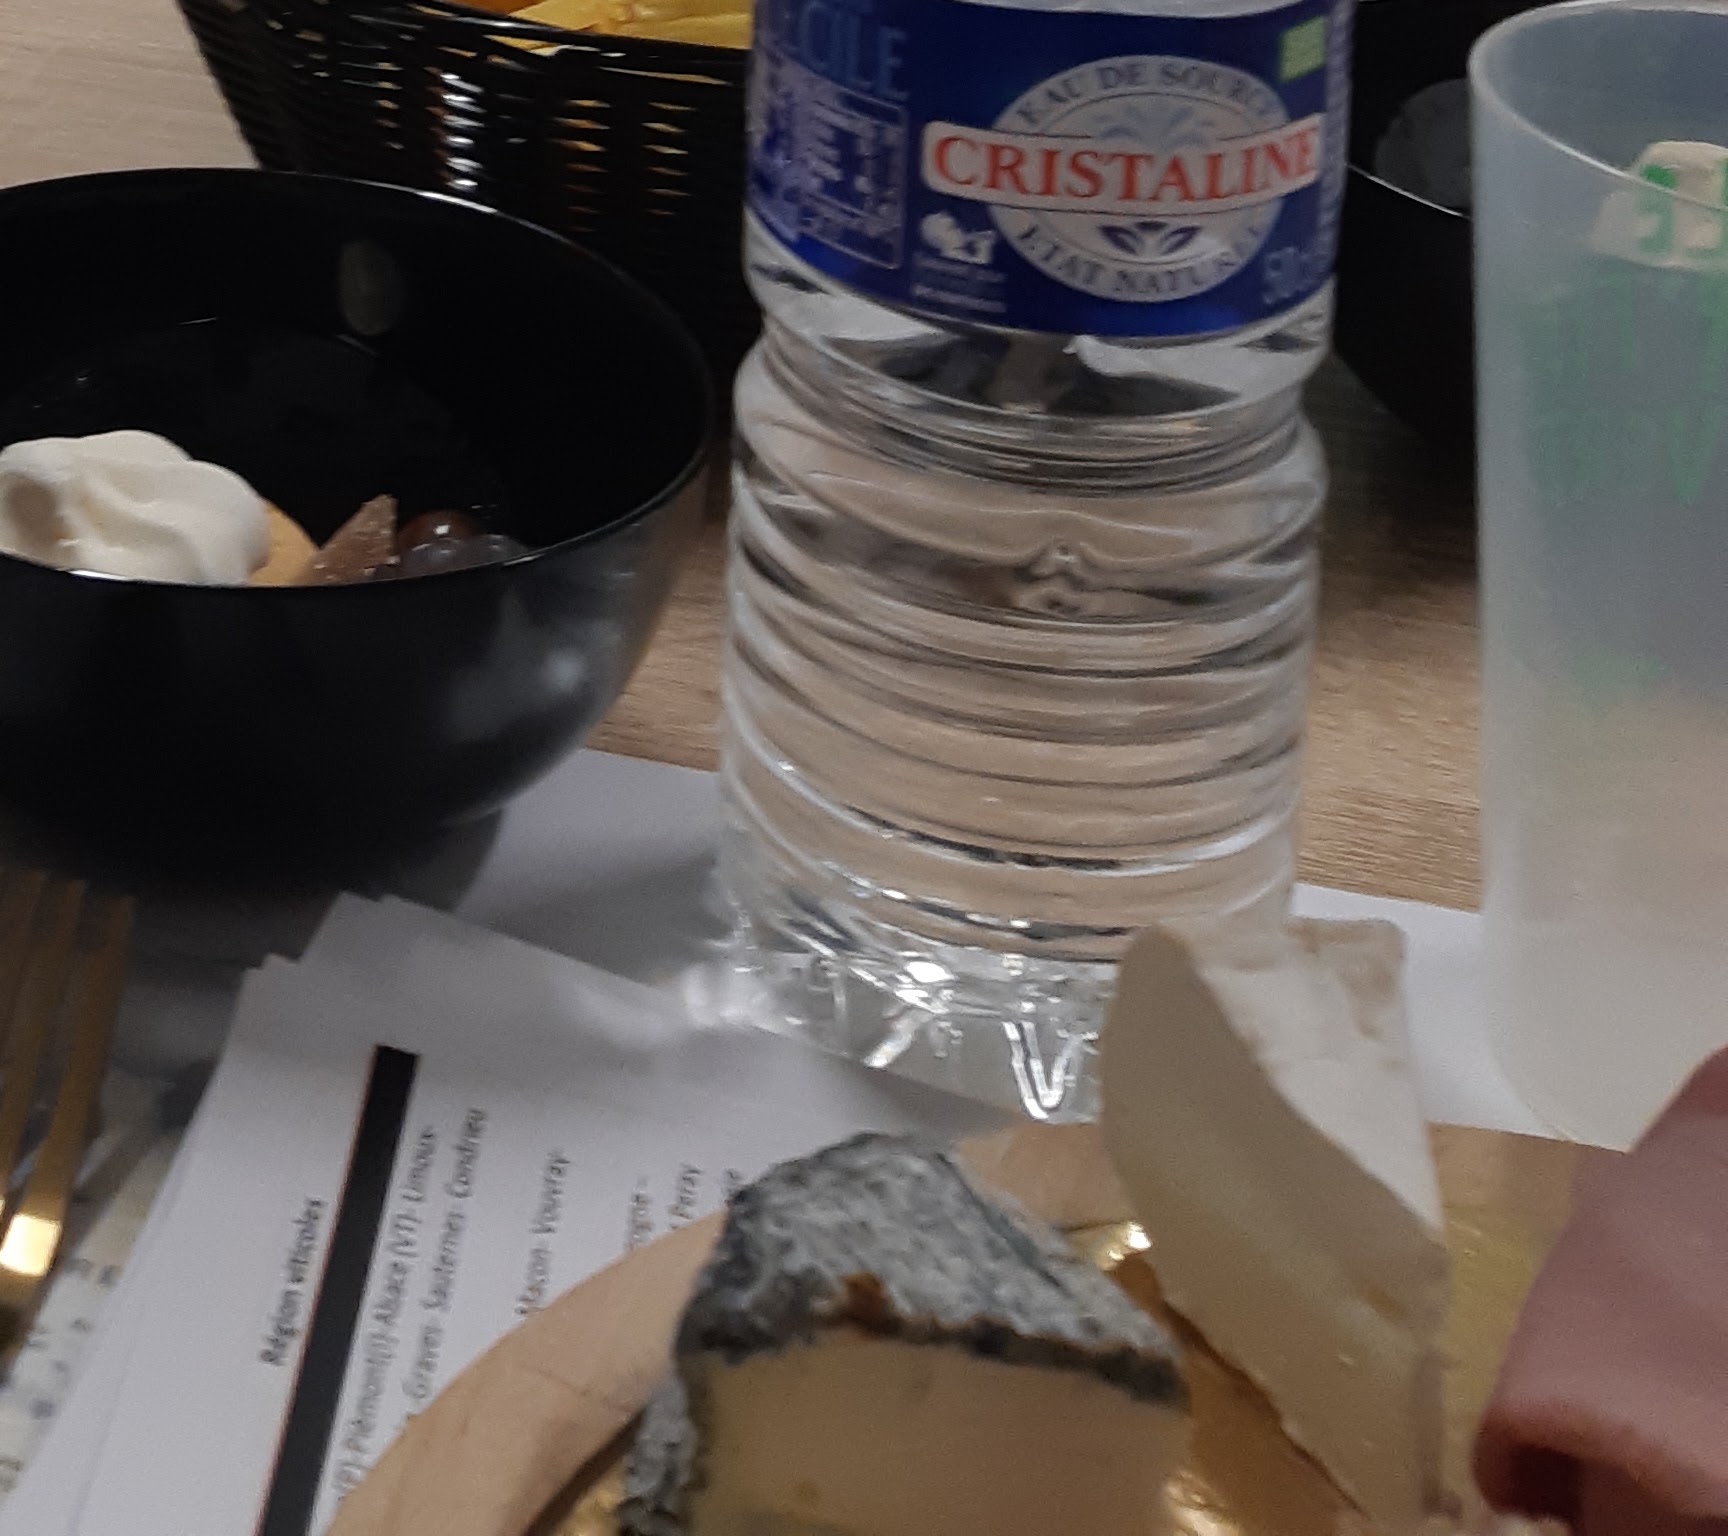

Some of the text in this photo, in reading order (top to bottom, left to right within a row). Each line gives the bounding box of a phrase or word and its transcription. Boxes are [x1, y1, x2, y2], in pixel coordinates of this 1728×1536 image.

[1015, 78, 1082, 126] EAU
[1099, 64, 1144, 89] DE
[933, 127, 1319, 203] CRISTALINE
[258, 1197, 327, 1366] Région viticoles
